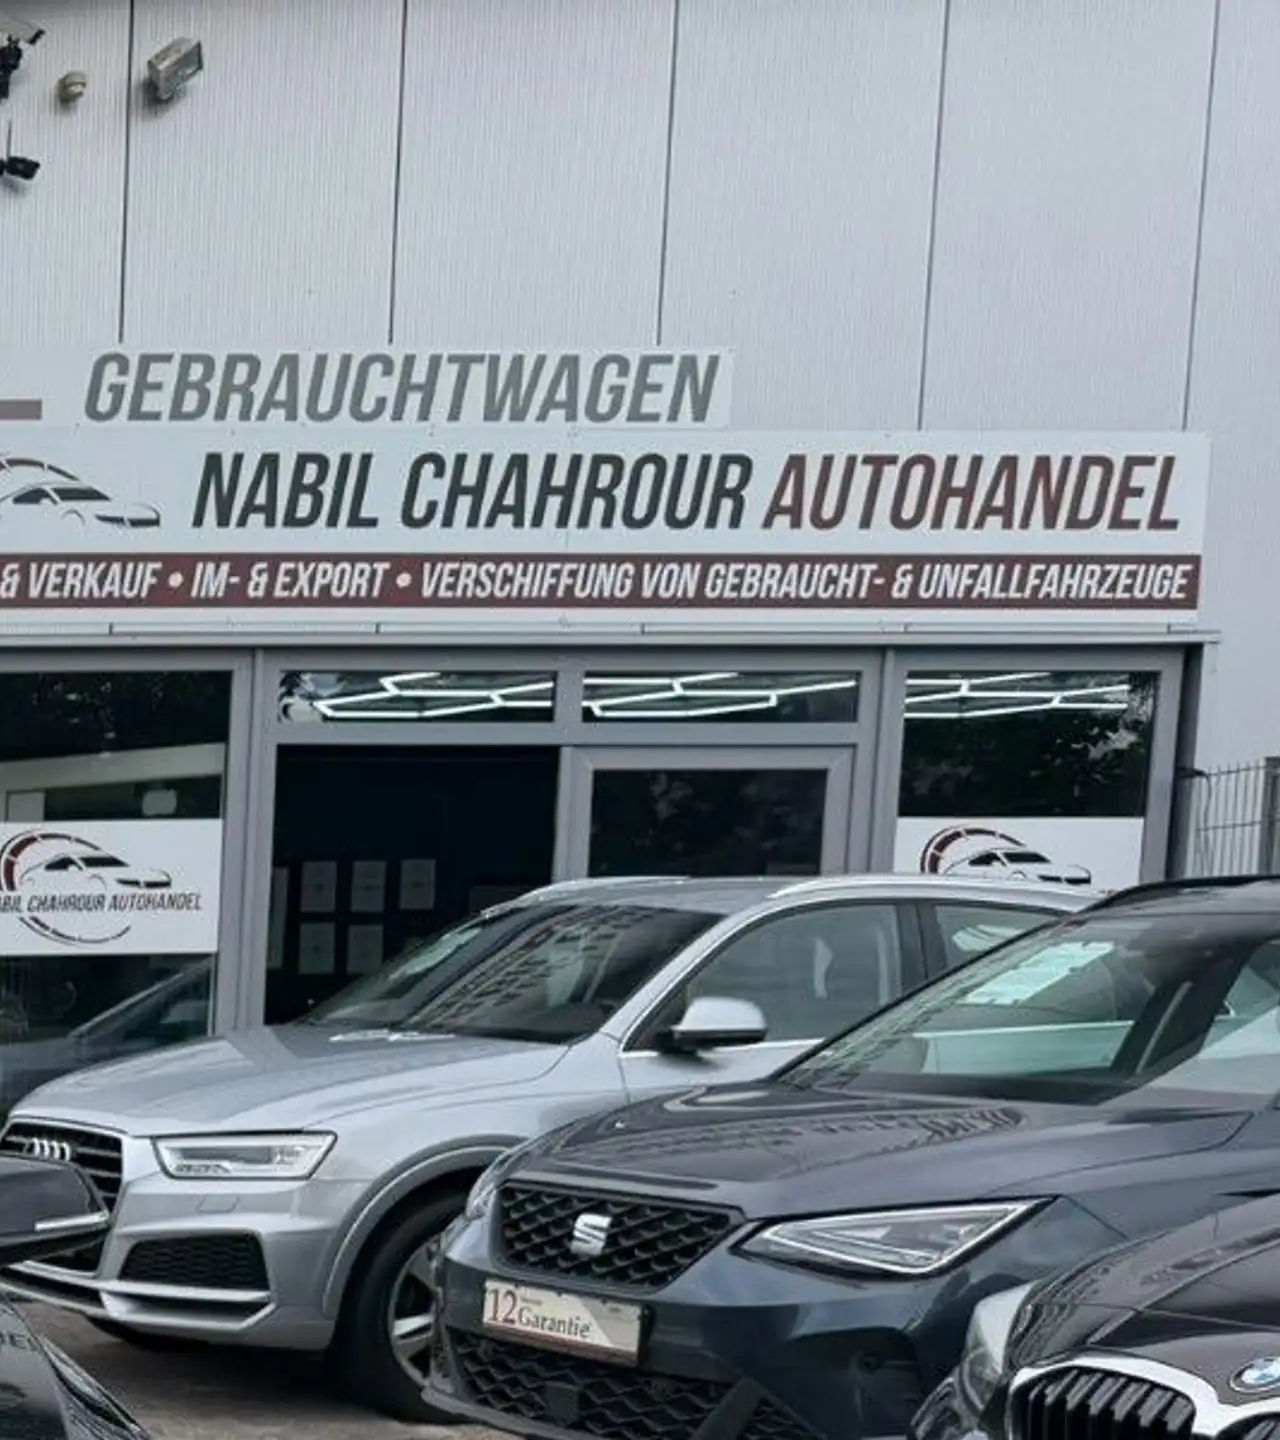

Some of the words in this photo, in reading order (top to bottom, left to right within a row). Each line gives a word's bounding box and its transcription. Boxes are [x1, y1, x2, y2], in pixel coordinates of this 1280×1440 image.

[84, 351, 721, 423] GEBRAUCHTWAGEN
[192, 452, 378, 529] NABIL
[401, 452, 753, 530] CHAHROUR
[762, 454, 1180, 530] AUTOHANDEL
[0, 563, 20, 599] &
[27, 561, 162, 599] VERKAUF
[191, 561, 239, 599] IM-
[248, 563, 268, 599] &
[274, 561, 385, 599] EXPORT
[421, 562, 635, 600] VERSCHIFFUNG
[642, 563, 702, 600] VON
[705, 563, 885, 600] GEBRAUCHT-
[893, 563, 912, 600] &
[918, 563, 1193, 600] UNFALLFAHRZEUGE
[27, 894, 106, 912] CHAHROUR
[108, 893, 202, 911] AUTOHANDEL
[490, 1288, 517, 1325] 12
[518, 1306, 591, 1338] Garantie
